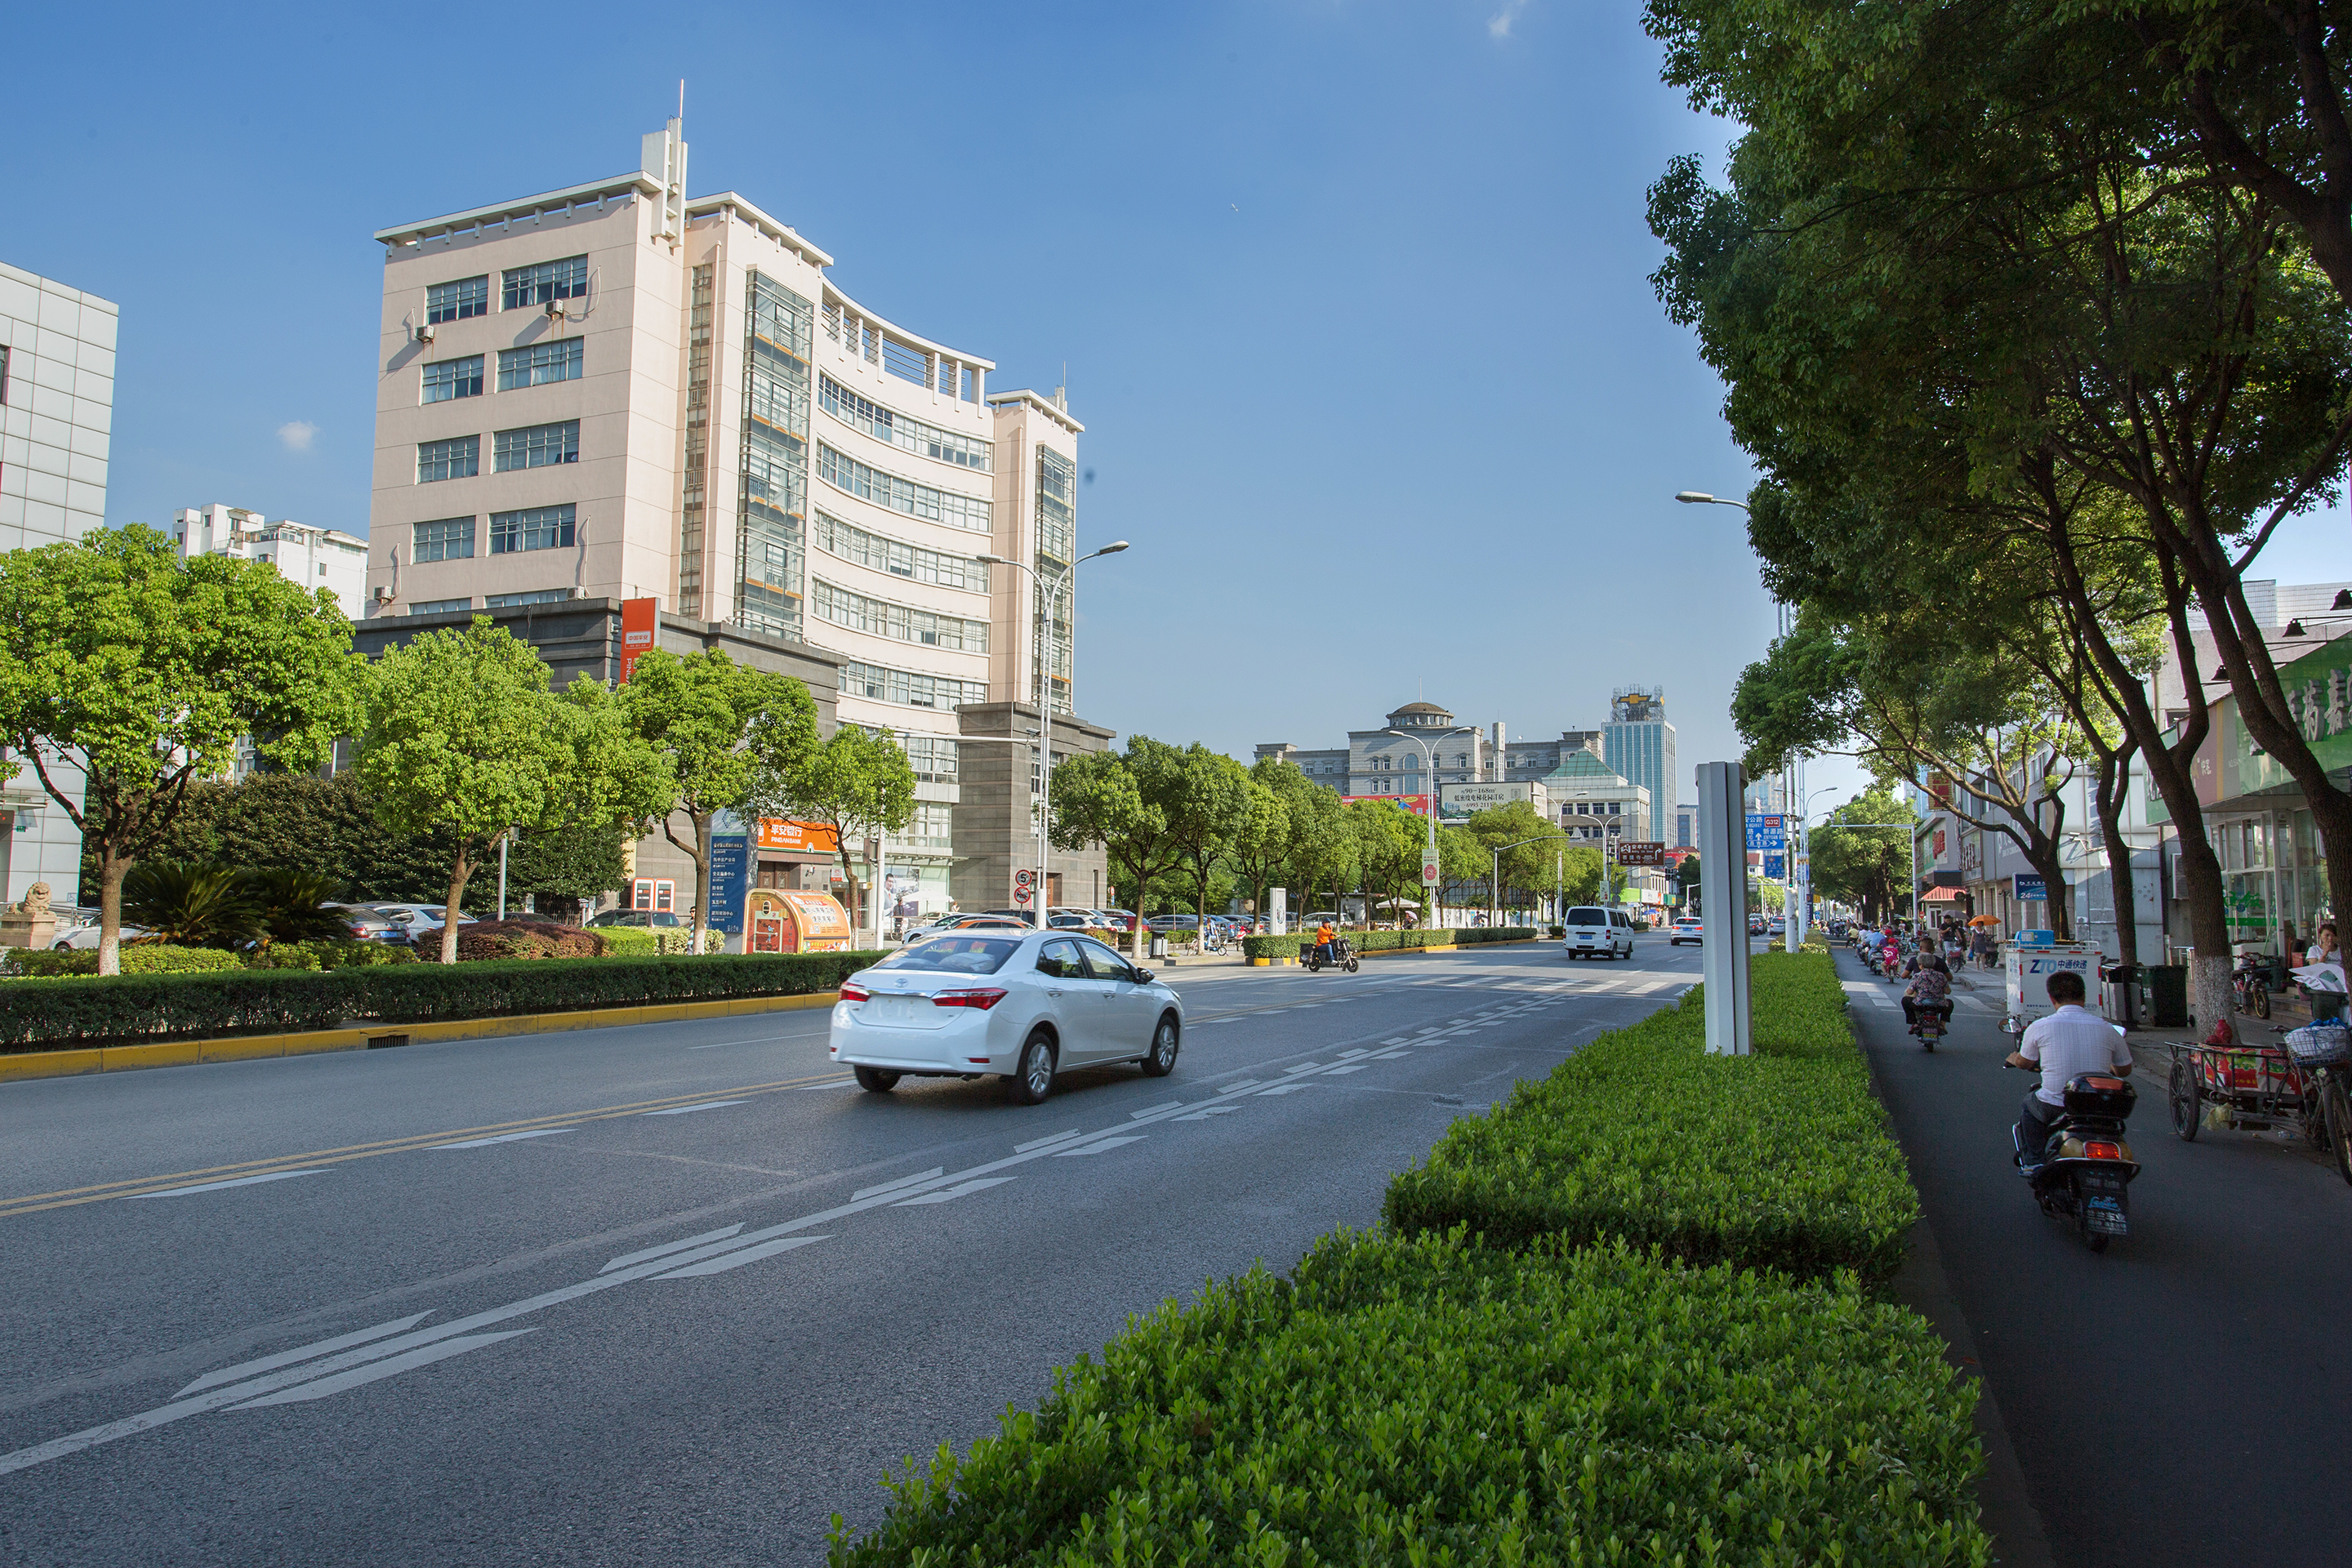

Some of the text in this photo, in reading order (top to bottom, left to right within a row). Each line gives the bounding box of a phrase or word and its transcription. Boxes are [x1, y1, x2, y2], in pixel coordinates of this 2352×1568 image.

[770, 824, 803, 837] 平安银行
[1019, 873, 1028, 882] 5
[2029, 959, 2057, 974] ZTO
[2057, 959, 2087, 969] 中通快递
